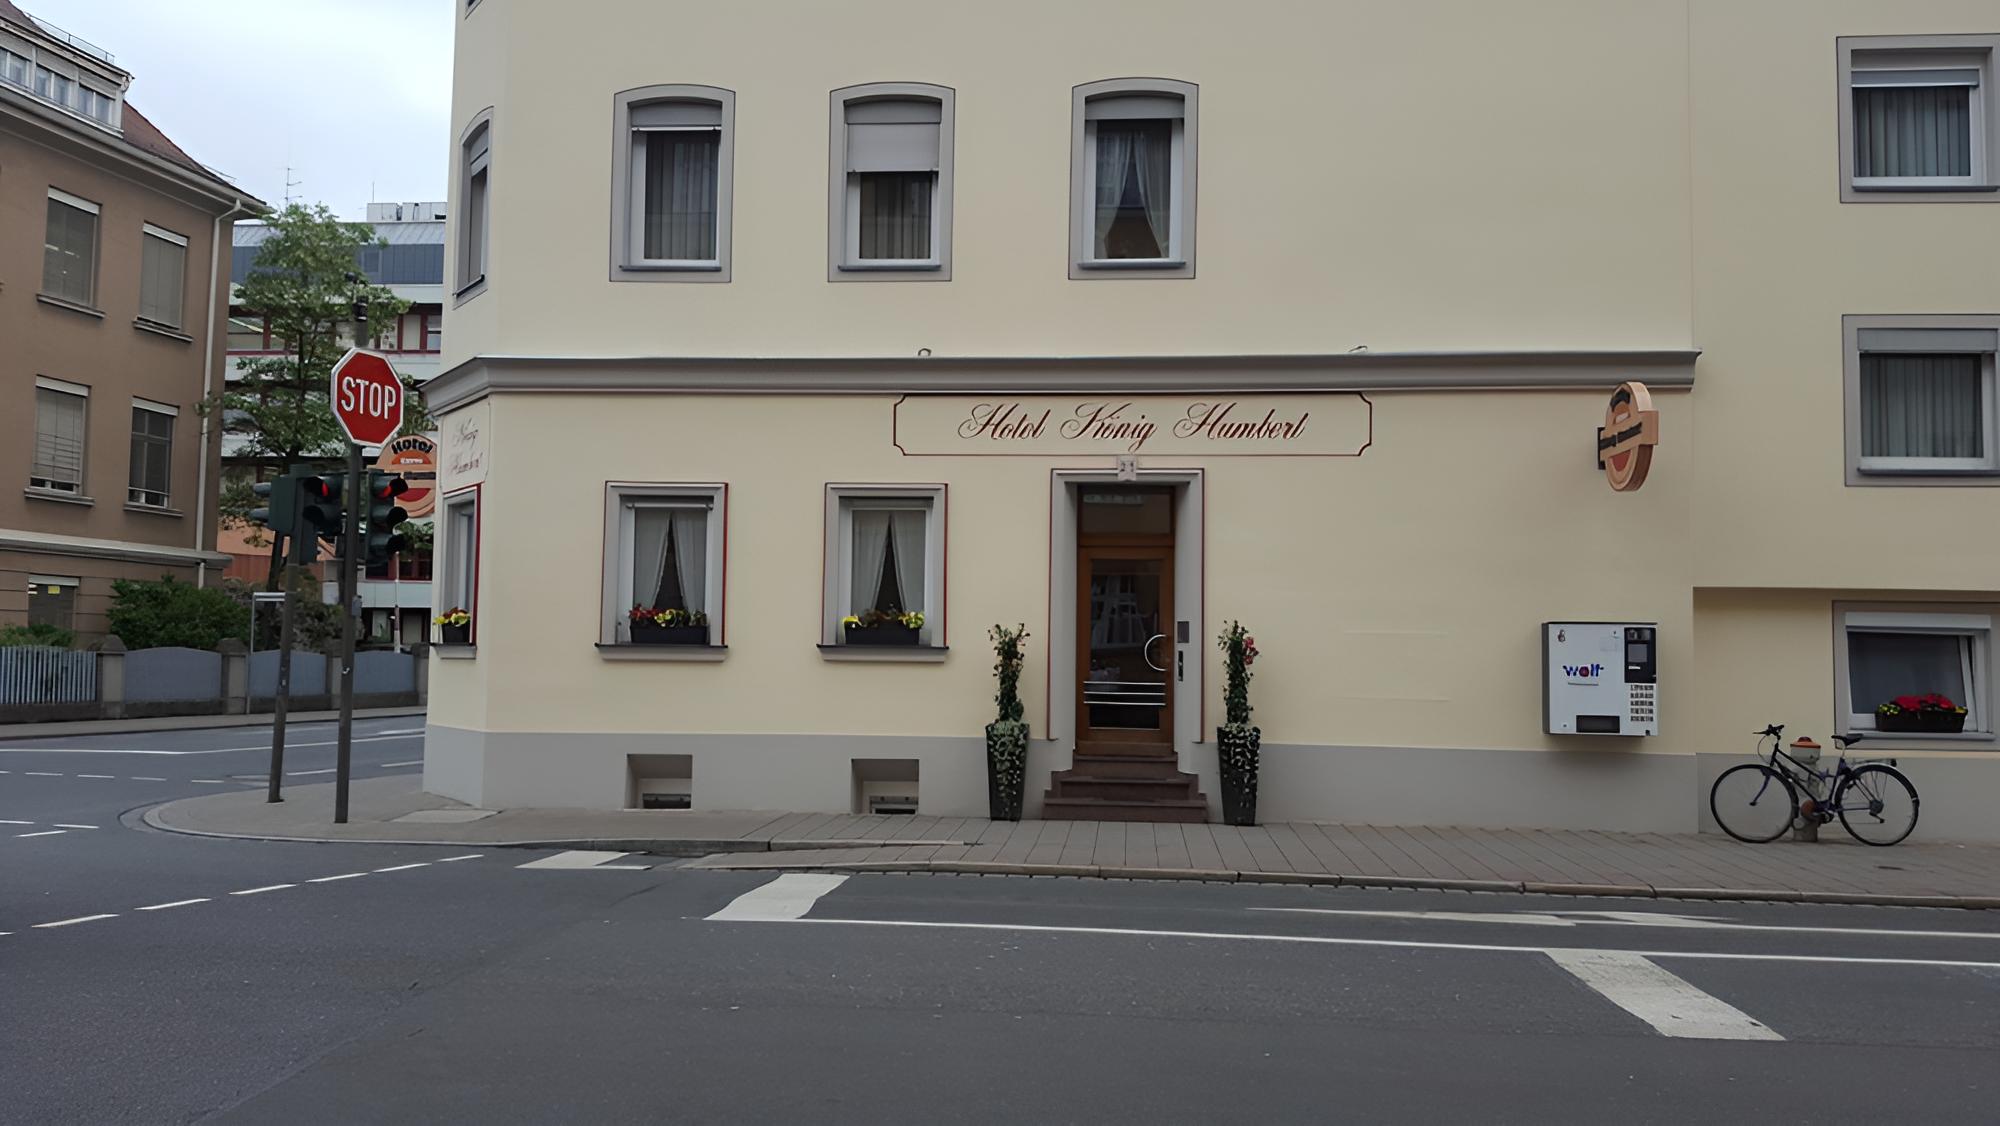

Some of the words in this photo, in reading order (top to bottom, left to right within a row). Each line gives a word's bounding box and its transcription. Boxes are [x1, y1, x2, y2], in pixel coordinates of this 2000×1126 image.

[340, 375, 397, 420] STOP
[391, 438, 434, 455] Hotel
[957, 402, 1051, 440] Hotel
[1059, 402, 1158, 454] König
[1172, 402, 1310, 440] Humbert
